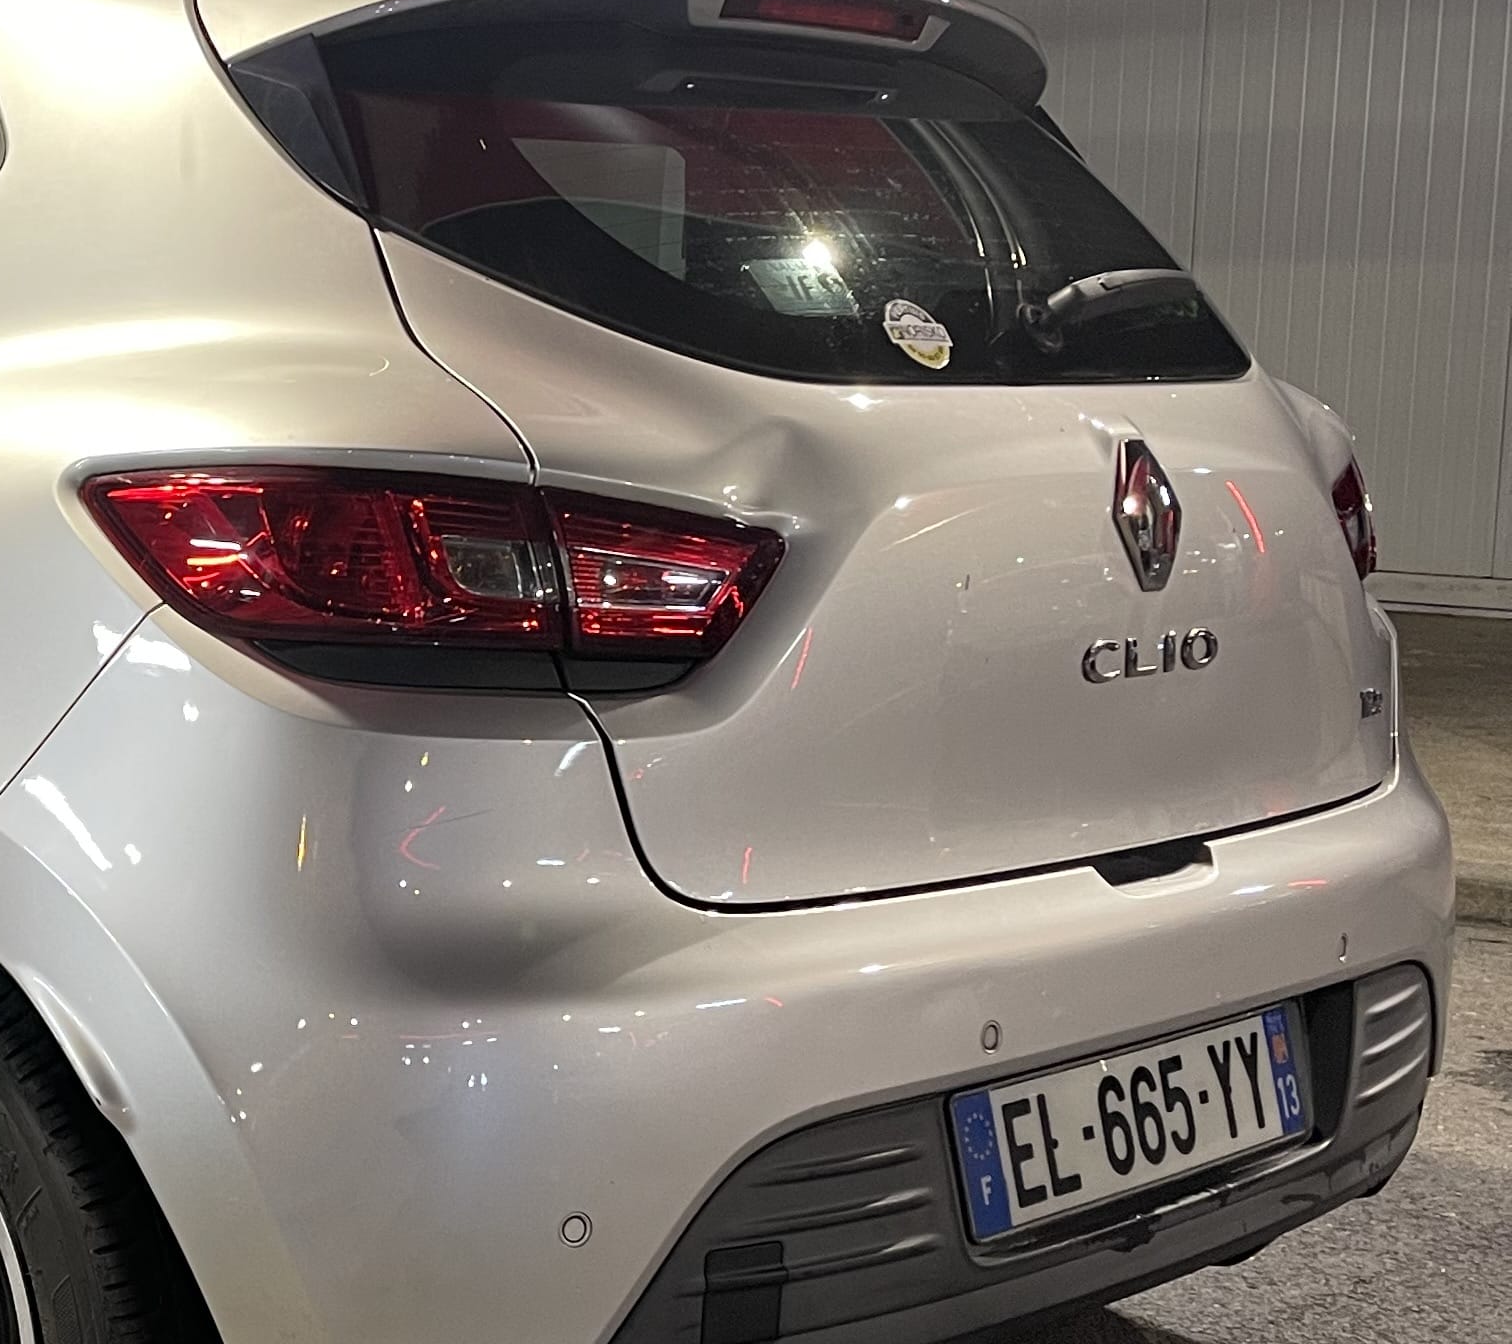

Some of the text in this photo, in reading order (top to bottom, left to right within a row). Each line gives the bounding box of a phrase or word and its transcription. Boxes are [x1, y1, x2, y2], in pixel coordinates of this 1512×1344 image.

[1082, 627, 1218, 684] CLIO
[1000, 1031, 1266, 1208] EL-665-YY
[1277, 1073, 1301, 1119] 13
[981, 1174, 993, 1206] F
